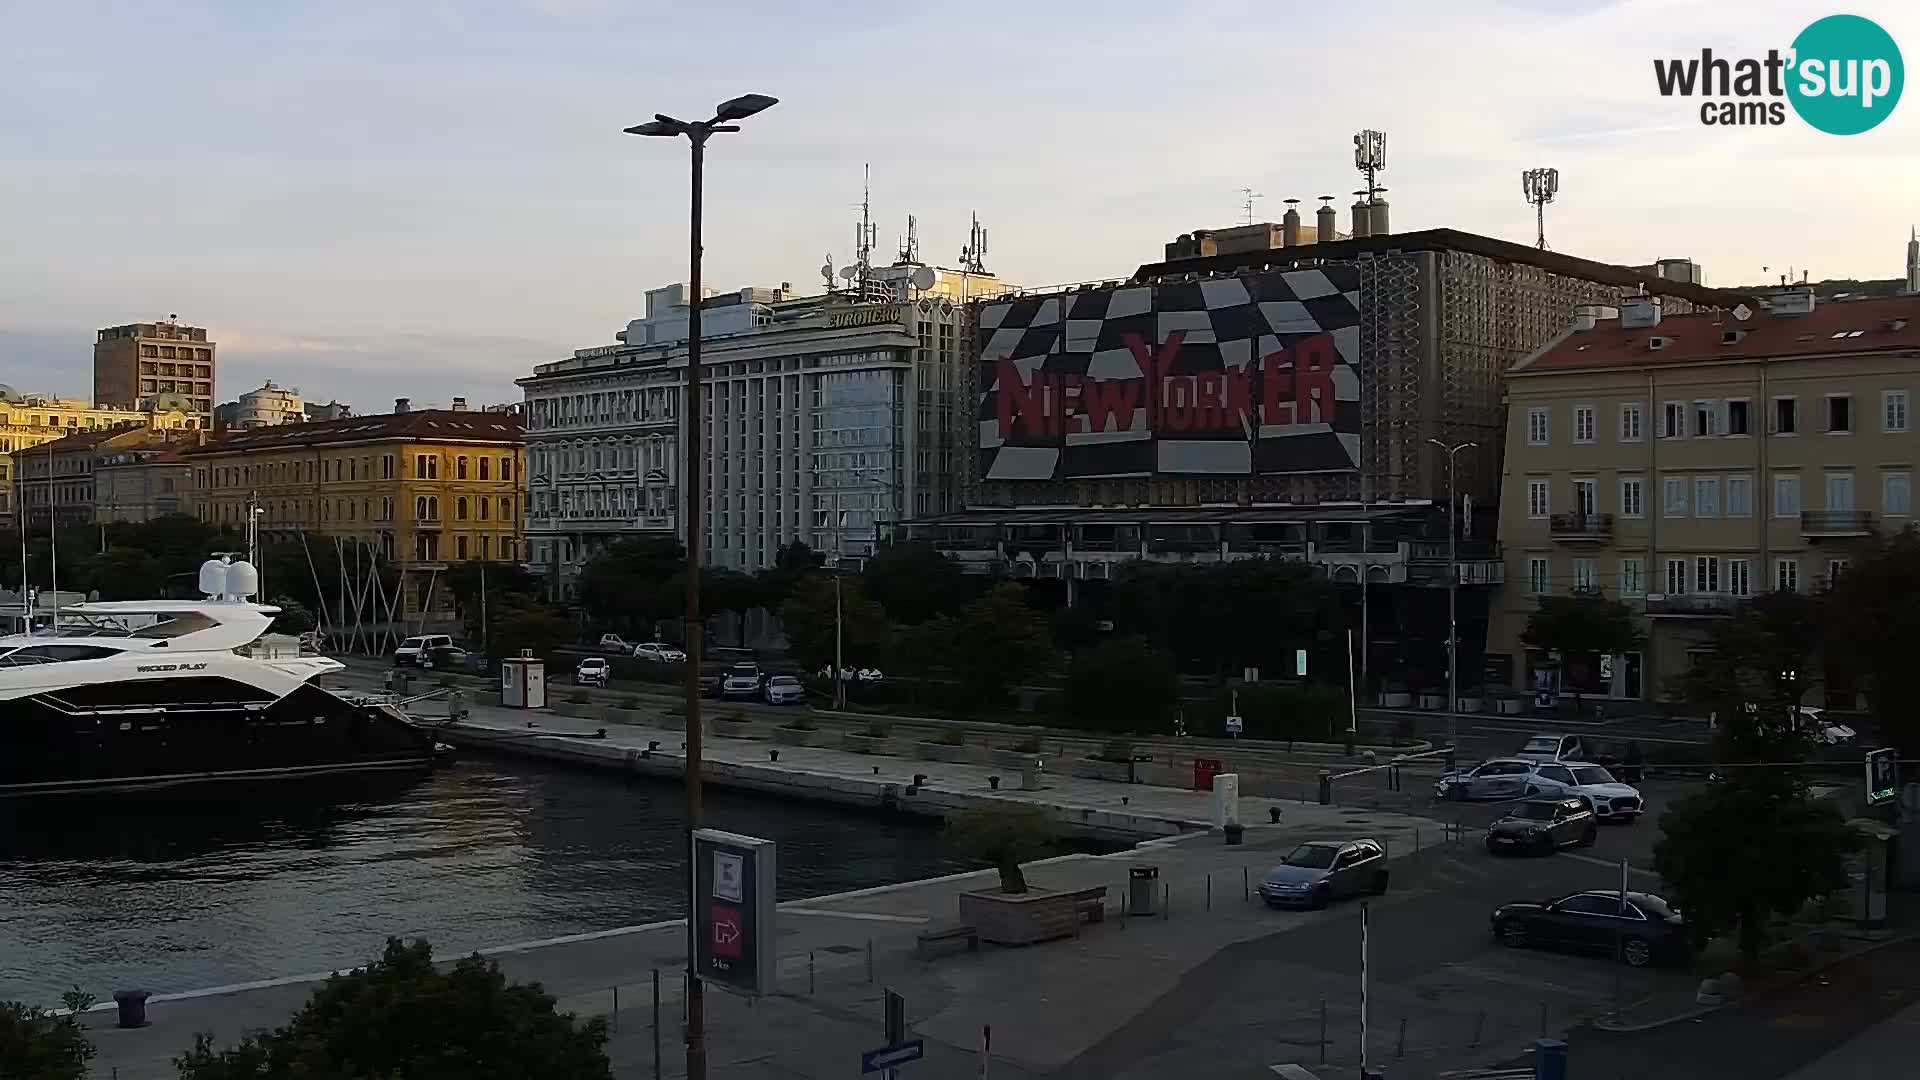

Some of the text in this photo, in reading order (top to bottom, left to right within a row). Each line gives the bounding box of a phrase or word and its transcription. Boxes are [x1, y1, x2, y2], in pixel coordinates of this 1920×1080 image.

[996, 329, 1336, 438] NEW YORKER
[179, 663, 207, 671] PLAY
